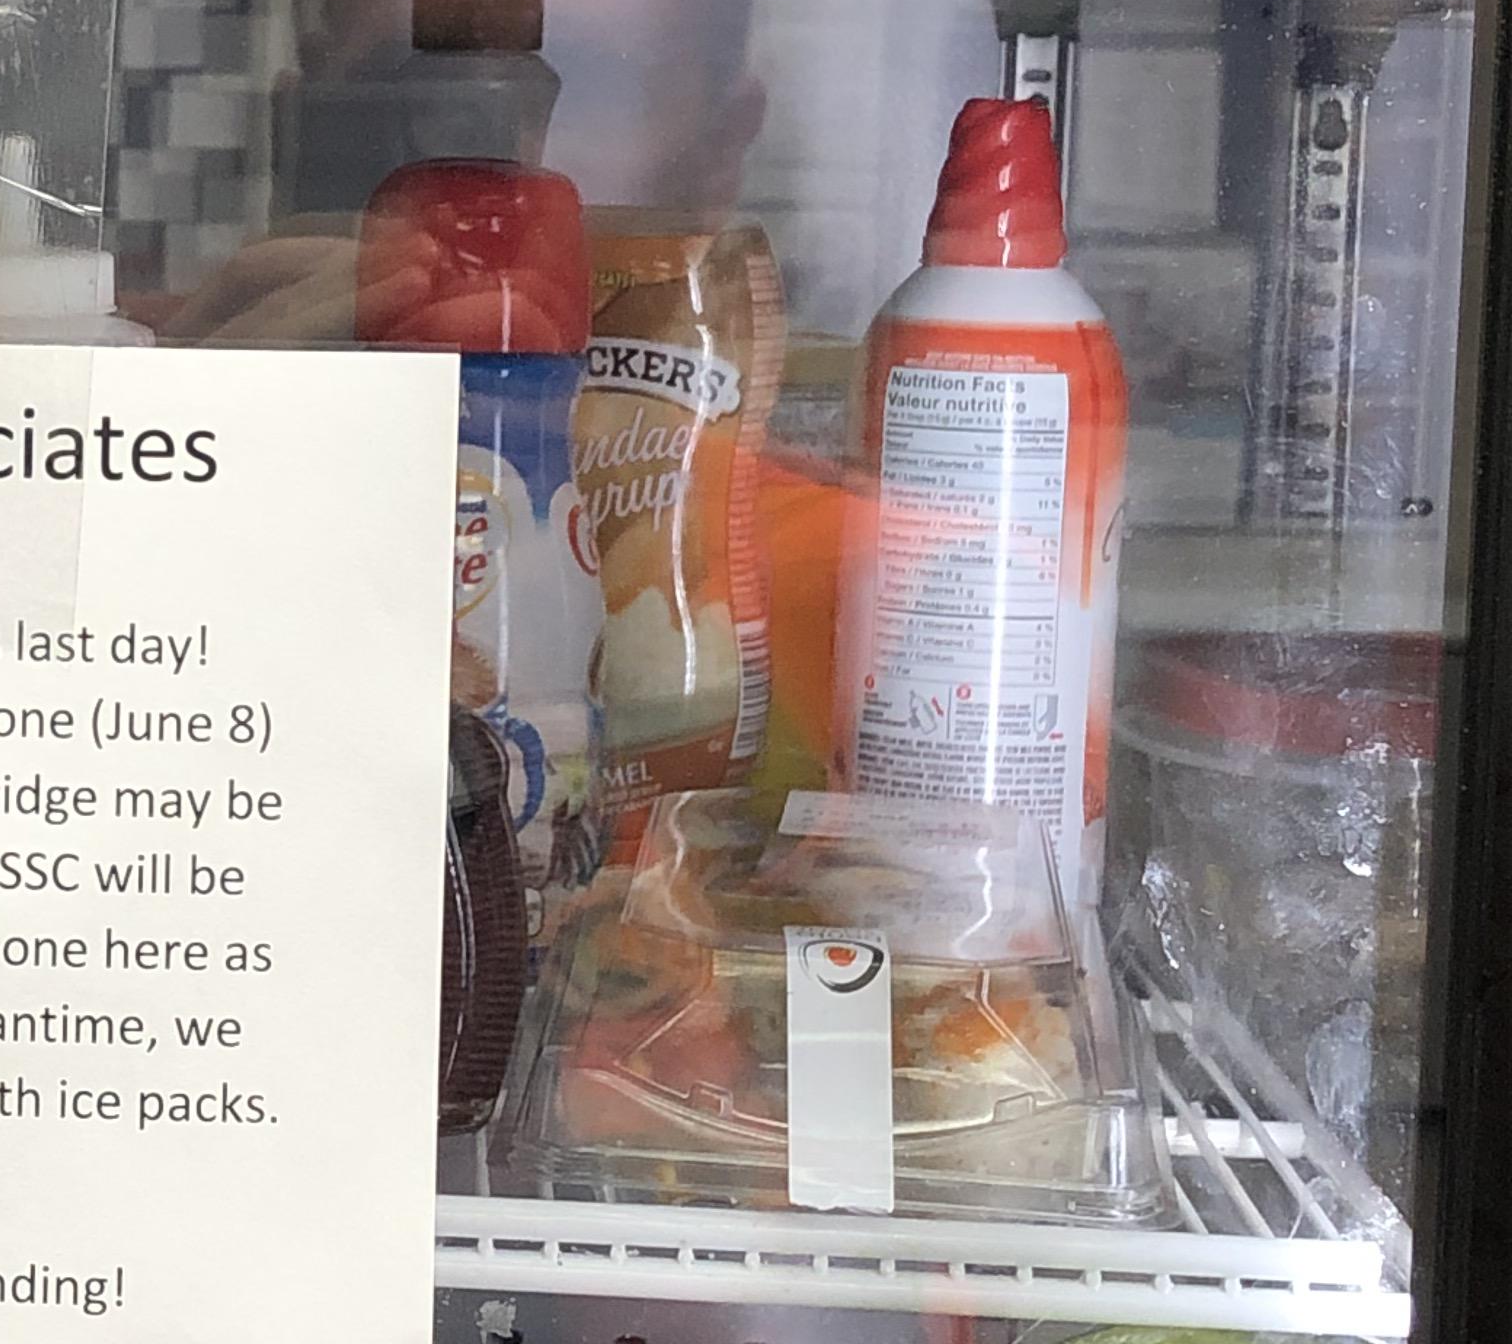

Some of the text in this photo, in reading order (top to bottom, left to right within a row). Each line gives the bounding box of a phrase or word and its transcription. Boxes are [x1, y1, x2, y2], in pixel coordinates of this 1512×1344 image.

[585, 346, 727, 404] CKERS
[891, 371, 1026, 395] Nutrition Facs
[888, 392, 1027, 415] Valeur nutritie
[576, 407, 691, 474] ndae
[17, 620, 95, 663] last
[110, 622, 207, 675] day!
[91, 697, 212, 750] (June
[229, 701, 272, 754] 8)
[115, 788, 212, 829] may
[228, 778, 282, 821] be
[94, 853, 171, 894] will
[190, 853, 245, 896] be
[2, 936, 88, 968] one
[105, 927, 209, 971] here
[225, 942, 272, 973] as
[174, 1017, 242, 1048] we
[60, 1079, 121, 1120] ice
[139, 1082, 278, 1131] packs.
